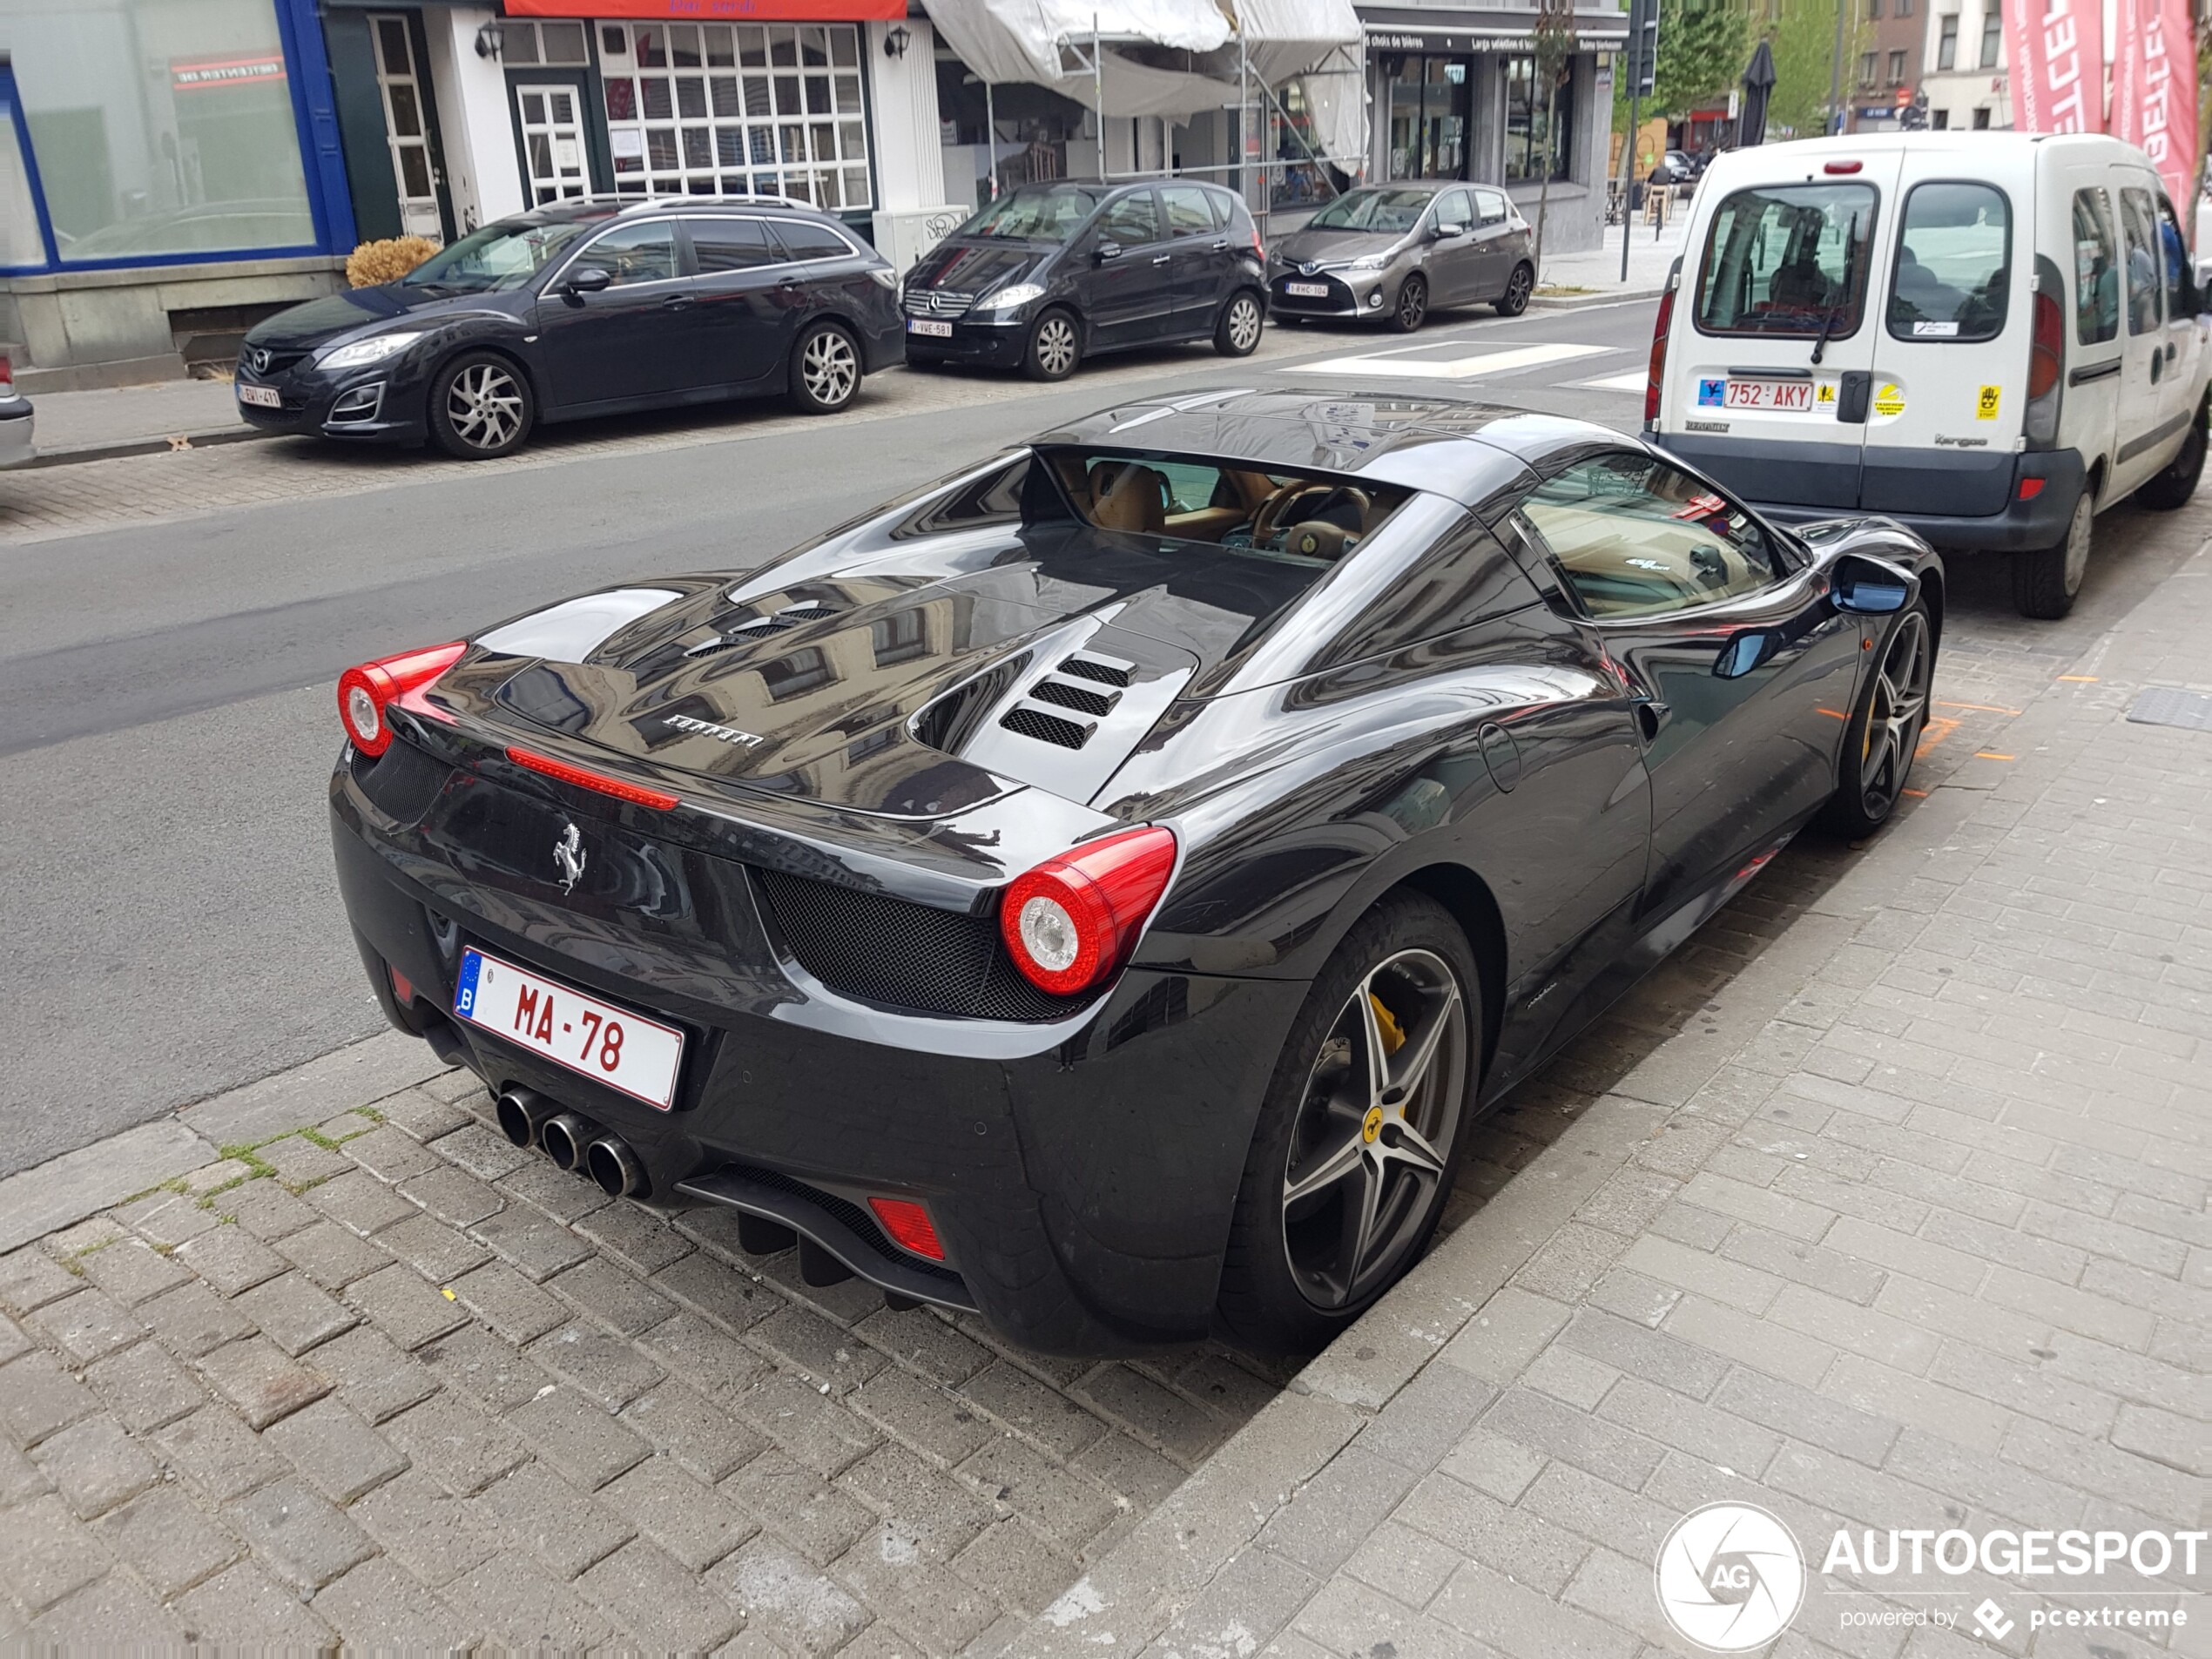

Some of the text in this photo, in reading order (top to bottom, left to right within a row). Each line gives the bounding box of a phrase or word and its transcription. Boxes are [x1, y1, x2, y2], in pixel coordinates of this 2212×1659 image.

[914, 321, 950, 335] 1-VWE-581
[1934, 433, 1988, 448] Kangoo
[461, 988, 473, 1011] B
[514, 983, 624, 1072] MA-78
